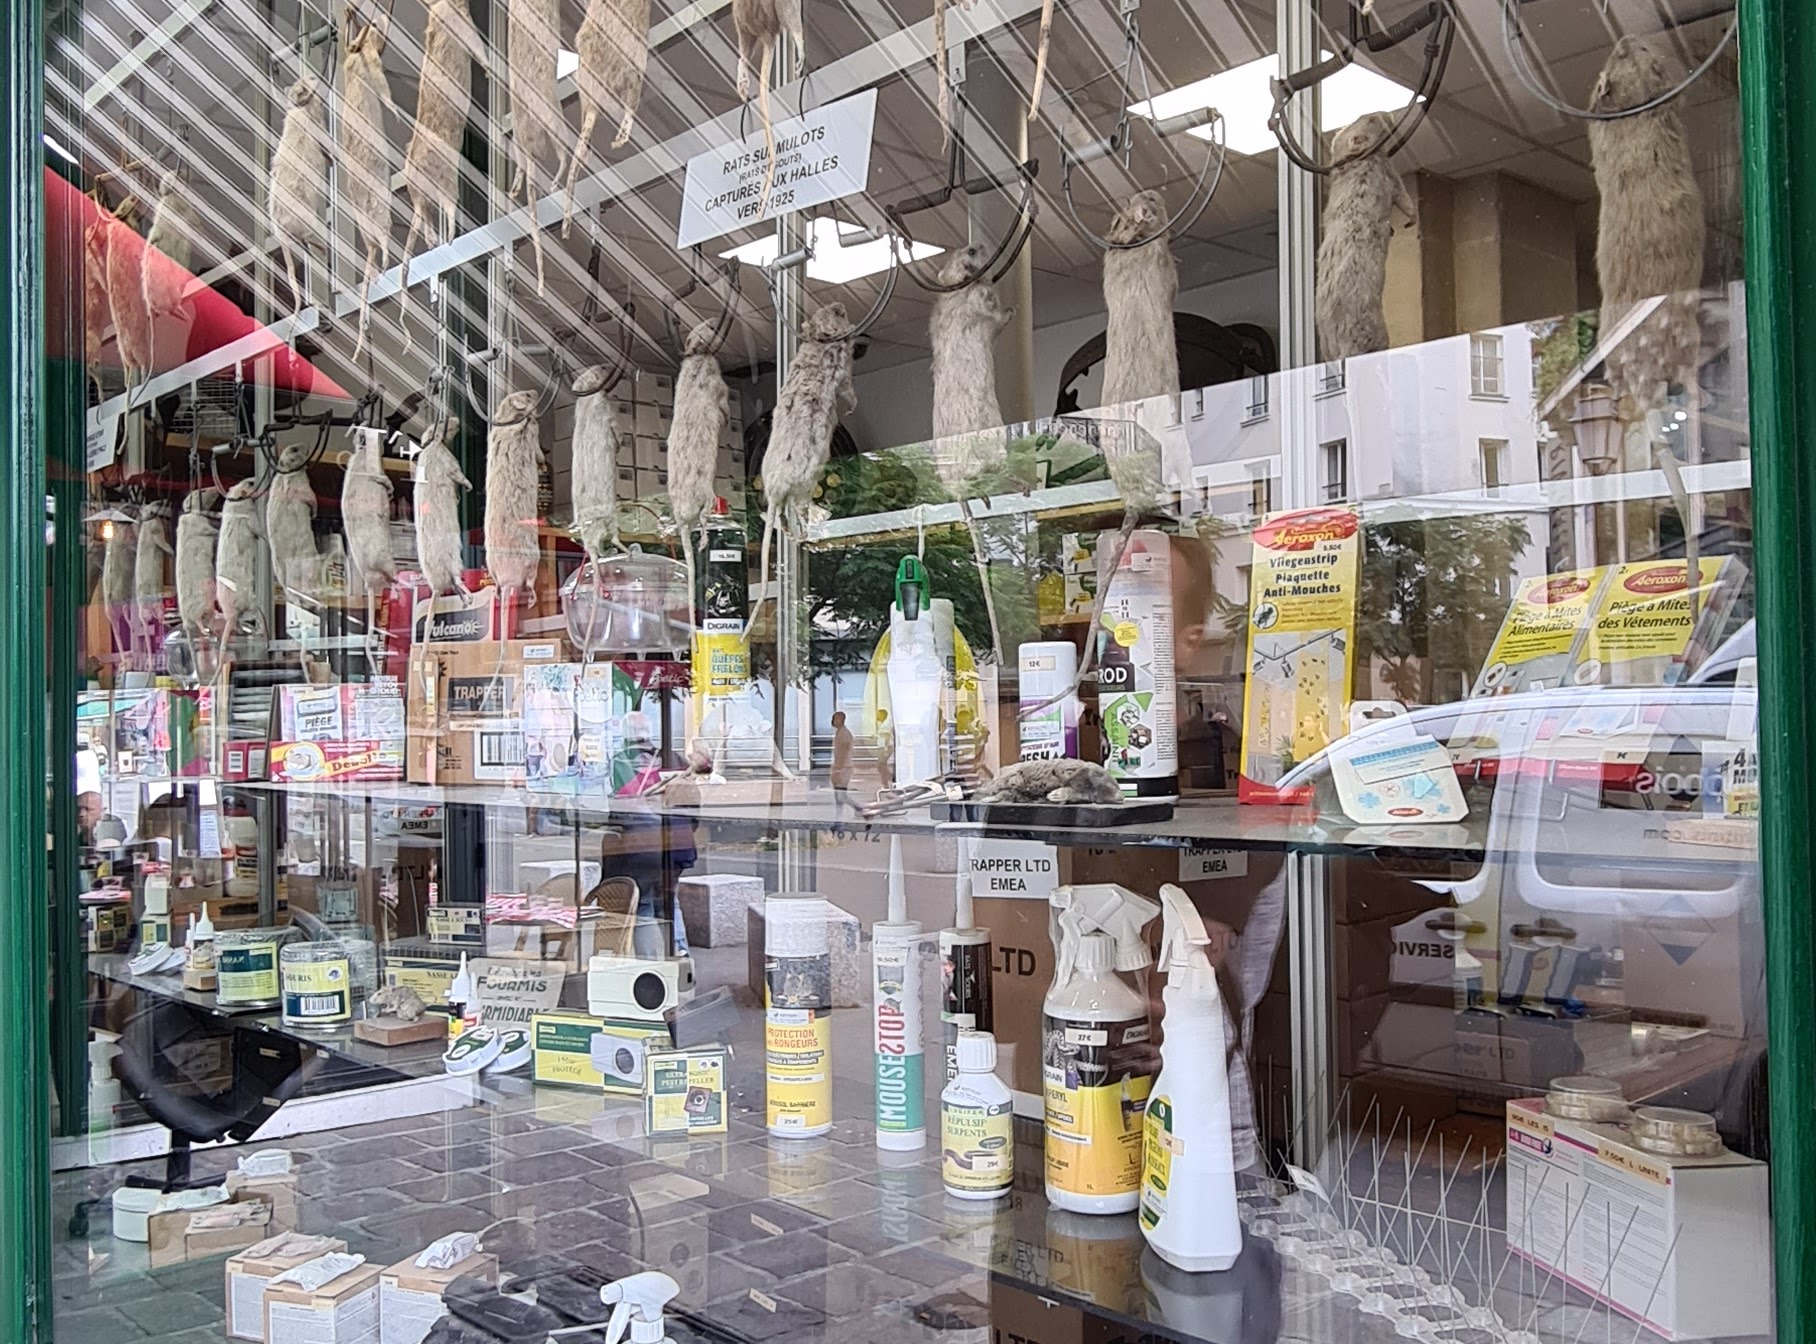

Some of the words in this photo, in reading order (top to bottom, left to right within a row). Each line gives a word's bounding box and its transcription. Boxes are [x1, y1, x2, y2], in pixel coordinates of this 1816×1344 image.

[722, 153, 751, 175] RATS
[790, 155, 839, 183] HALLES
[770, 190, 795, 209] 1925
[1272, 527, 1335, 545] Aeroxon
[1276, 570, 1330, 584] Plaquette
[1632, 570, 1688, 587] Aeroxon
[1263, 584, 1341, 598] Anti-Mouches
[1609, 601, 1643, 614] Piège
[1508, 620, 1574, 636] Alimentaires
[1598, 617, 1620, 629] des
[1623, 614, 1691, 629] Vêtements
[304, 715, 333, 728] PIÈGE
[1025, 860, 1050, 872] LTD
[1202, 860, 1228, 874] EMEA
[990, 878, 1027, 892] EMEA
[477, 976, 548, 993] FOURMIS
[768, 1027, 815, 1039] PROTECTION
[774, 1038, 819, 1049] RONGEURS
[947, 1126, 988, 1137] SERPENTS
[1528, 1119, 1539, 1130] LES
